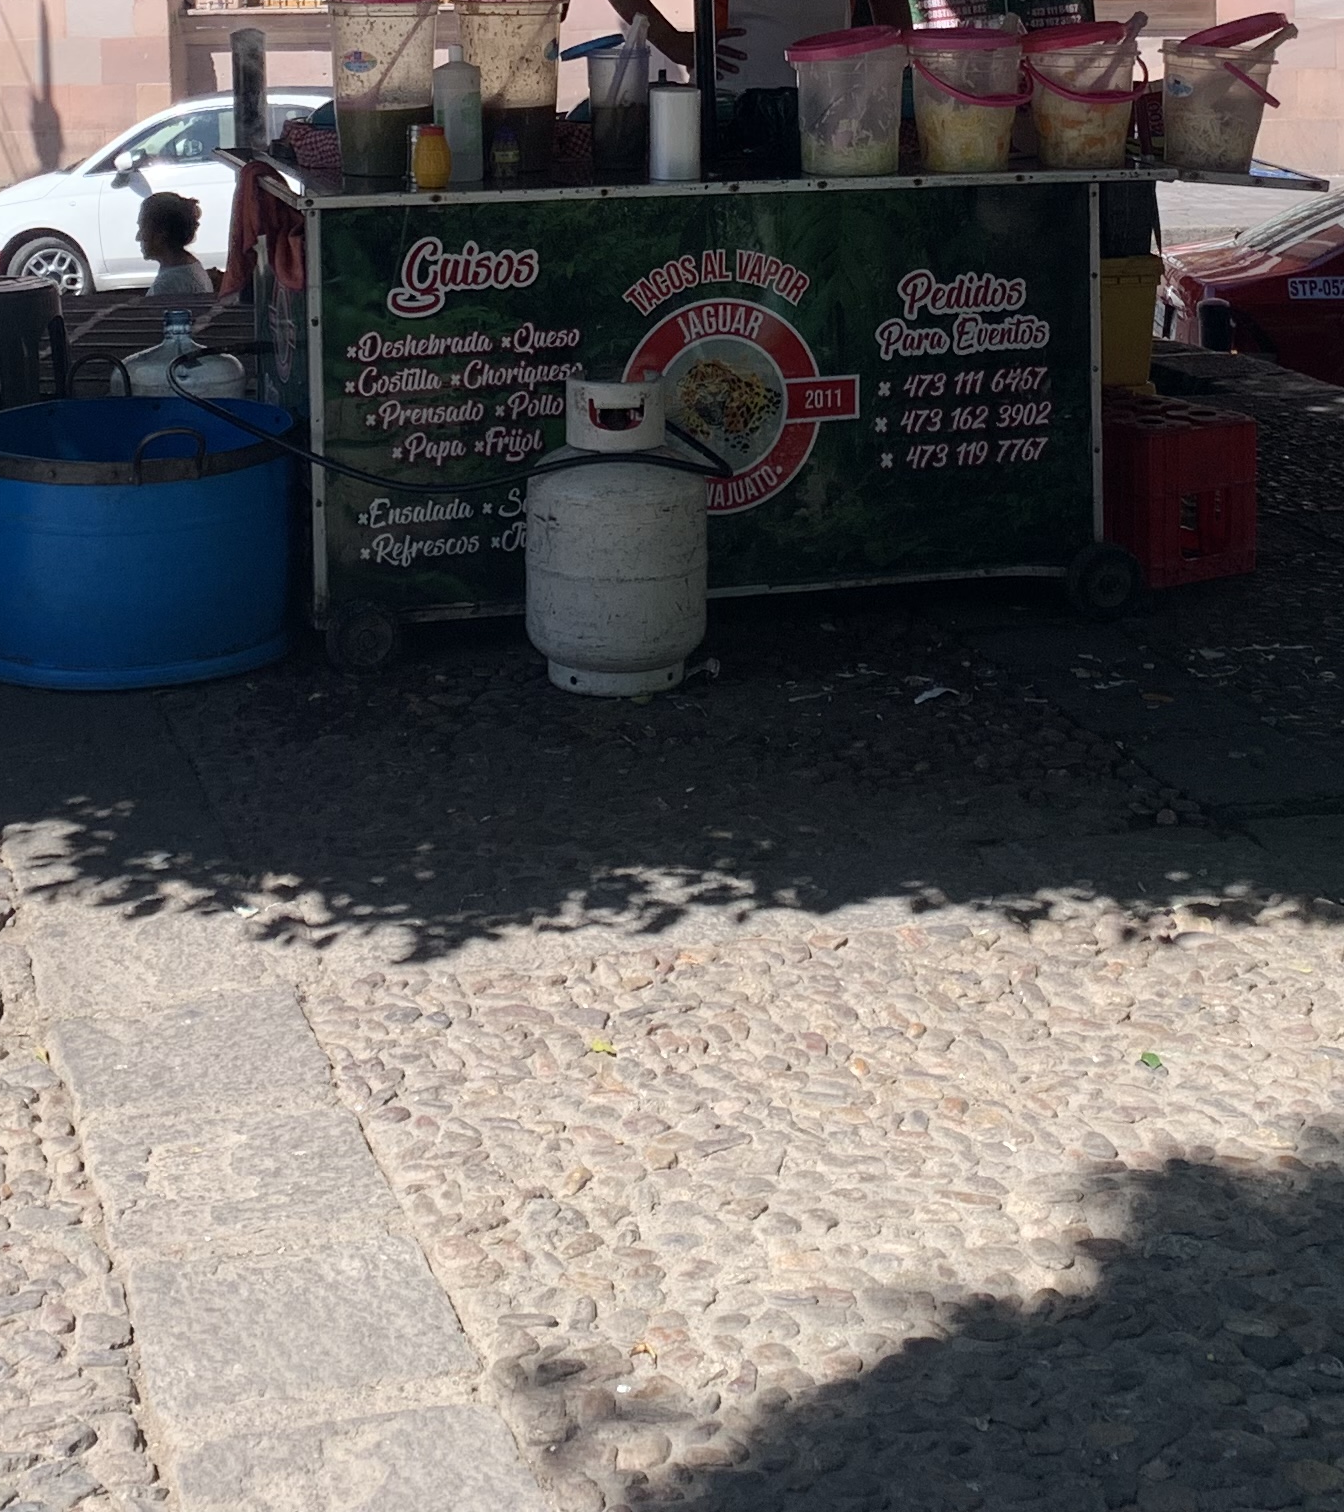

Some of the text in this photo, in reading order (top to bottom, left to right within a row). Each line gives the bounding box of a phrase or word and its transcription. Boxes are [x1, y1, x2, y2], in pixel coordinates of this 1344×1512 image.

[387, 236, 540, 319] Guisos
[622, 248, 811, 317] TACOS AL VAPOR
[898, 269, 1027, 320] Pedidos
[357, 322, 581, 363] Deshebrada Queso
[677, 304, 764, 343] JAGUAR
[875, 312, 1050, 360] Para Eventos
[357, 364, 442, 398] Costilla
[804, 389, 842, 409] 2011
[903, 372, 947, 398] 473
[955, 371, 985, 395] 111
[378, 400, 485, 430] Prensado
[507, 391, 564, 420] Pollo
[901, 401, 1053, 434] 473 162 3902
[403, 426, 544, 466] Papa Frijol
[906, 437, 1049, 469] 473 119 7767
[369, 495, 475, 529] Ensalada
[371, 531, 480, 568] Refrescos
